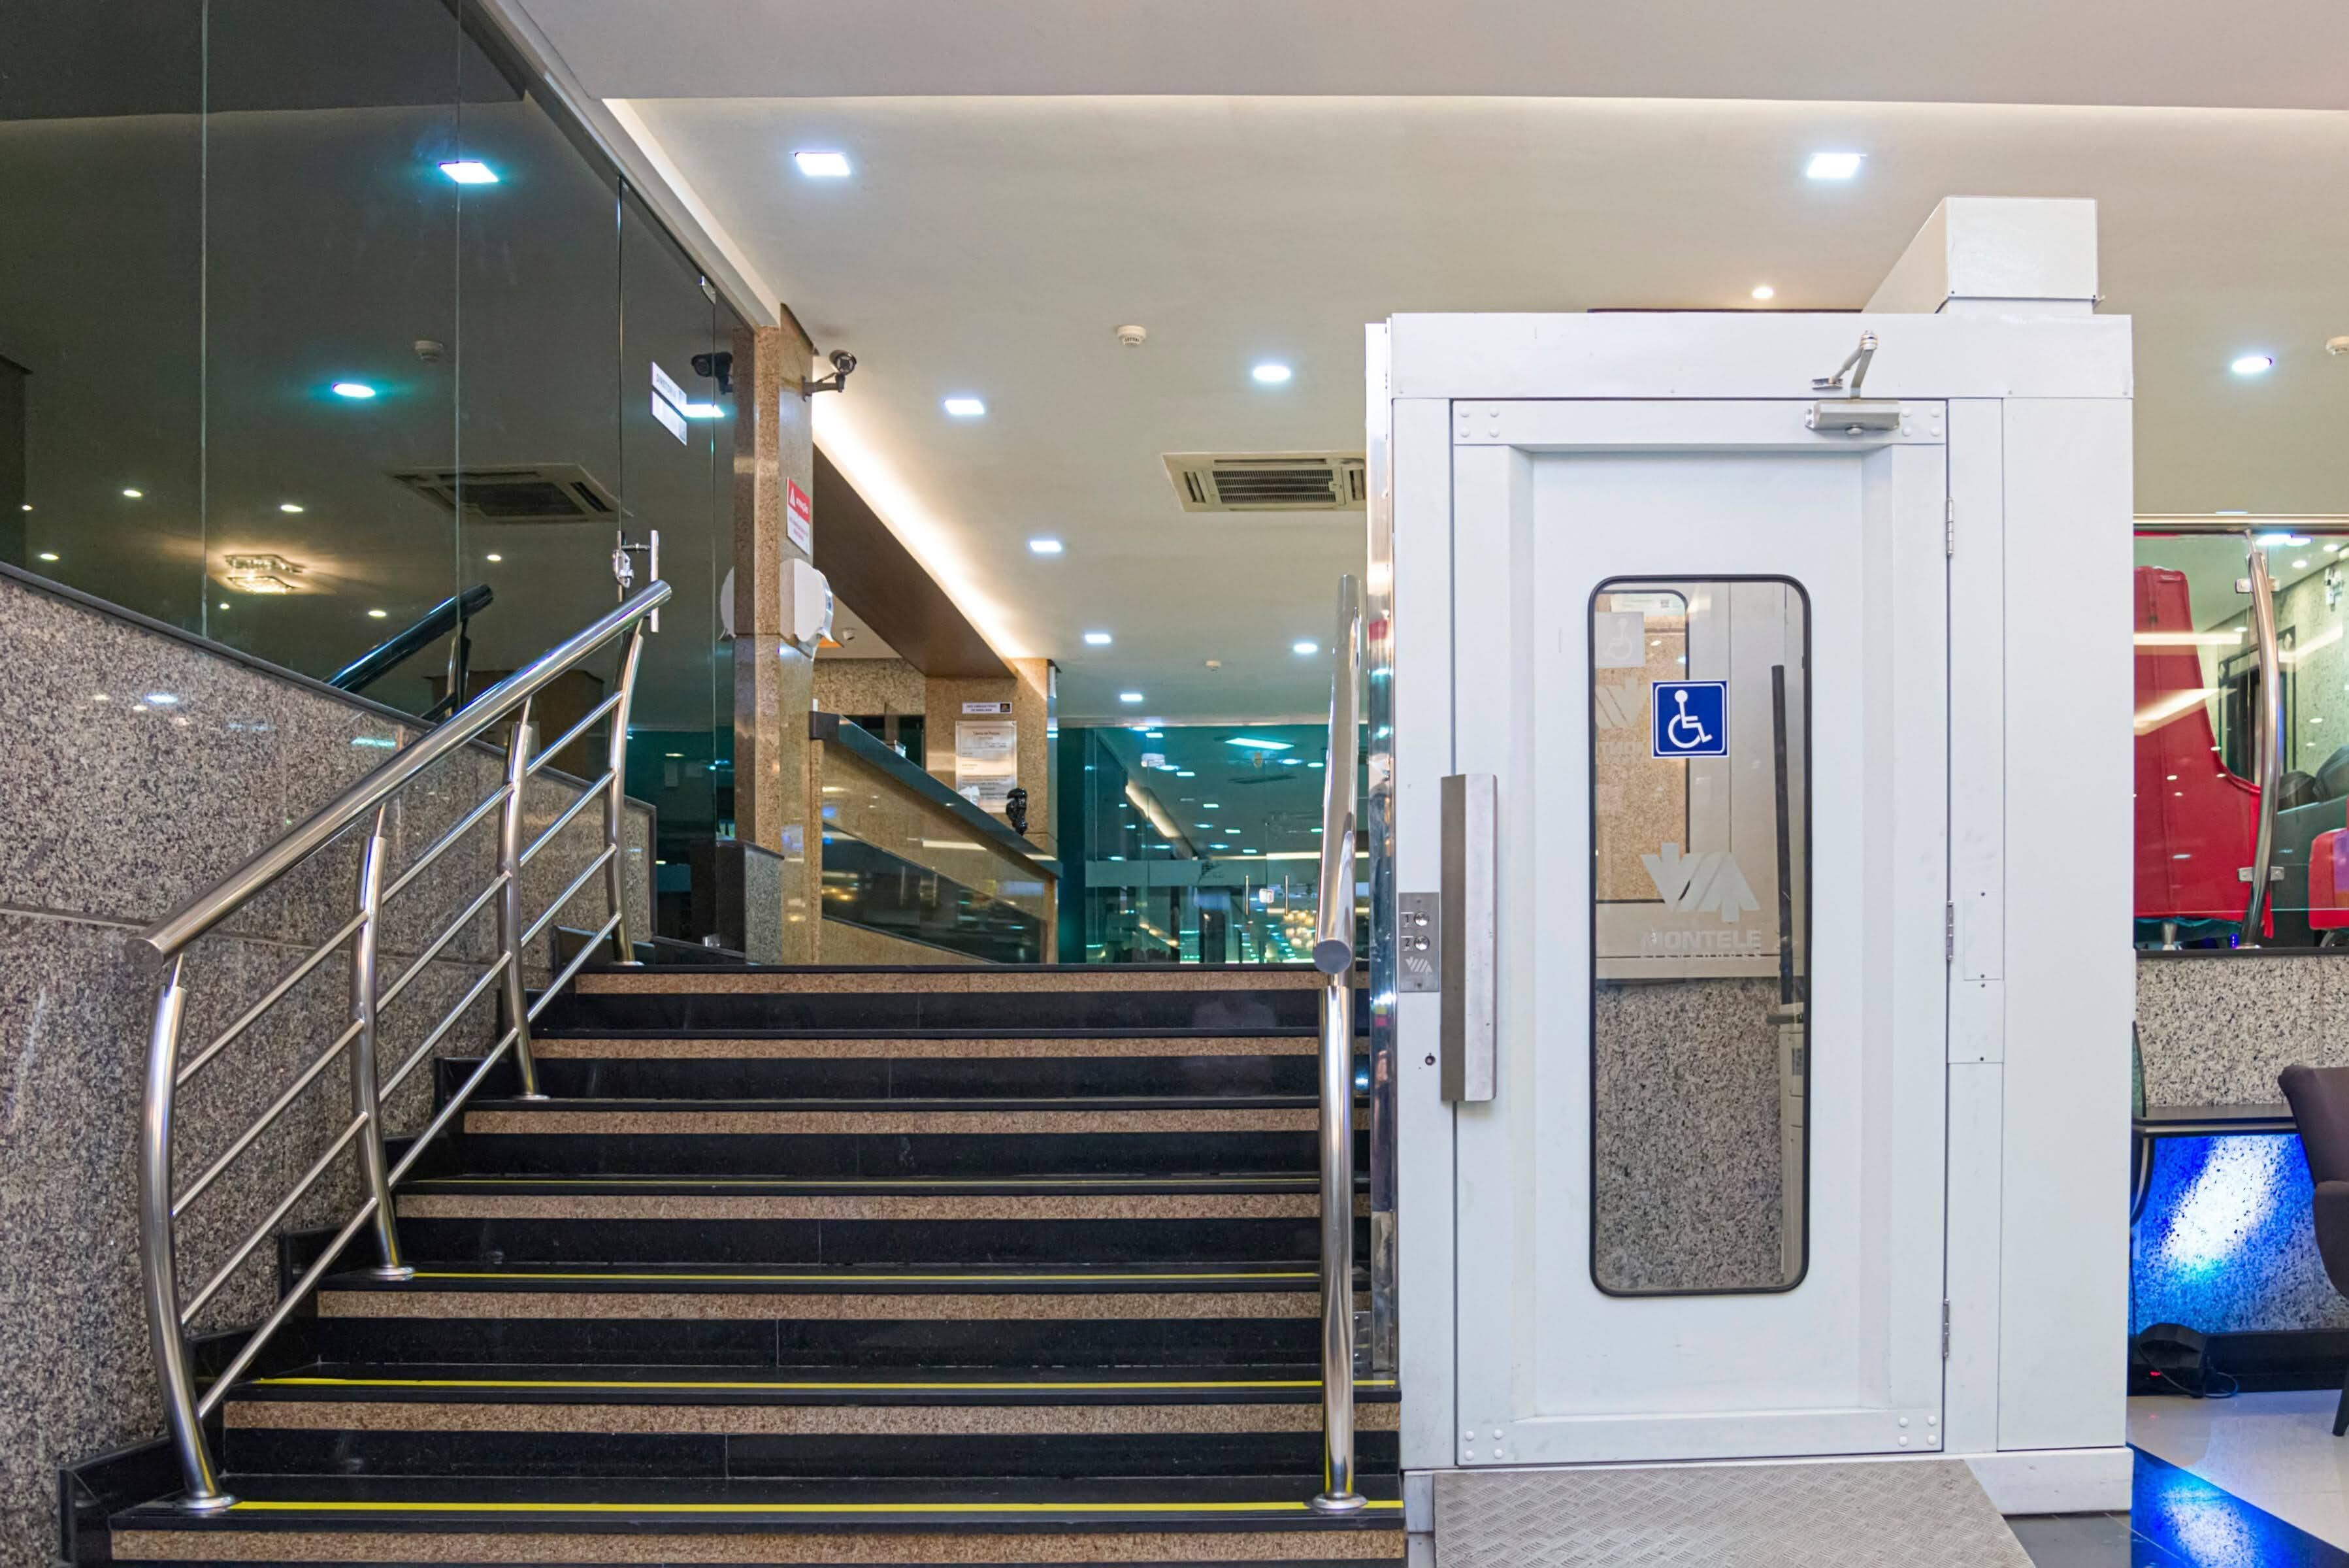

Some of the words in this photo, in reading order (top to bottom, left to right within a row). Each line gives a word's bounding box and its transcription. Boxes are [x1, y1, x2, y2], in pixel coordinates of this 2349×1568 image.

[1405, 914, 1409, 923] 1
[1405, 938, 1410, 947] 2
[1641, 930, 1762, 949] MONTELE
